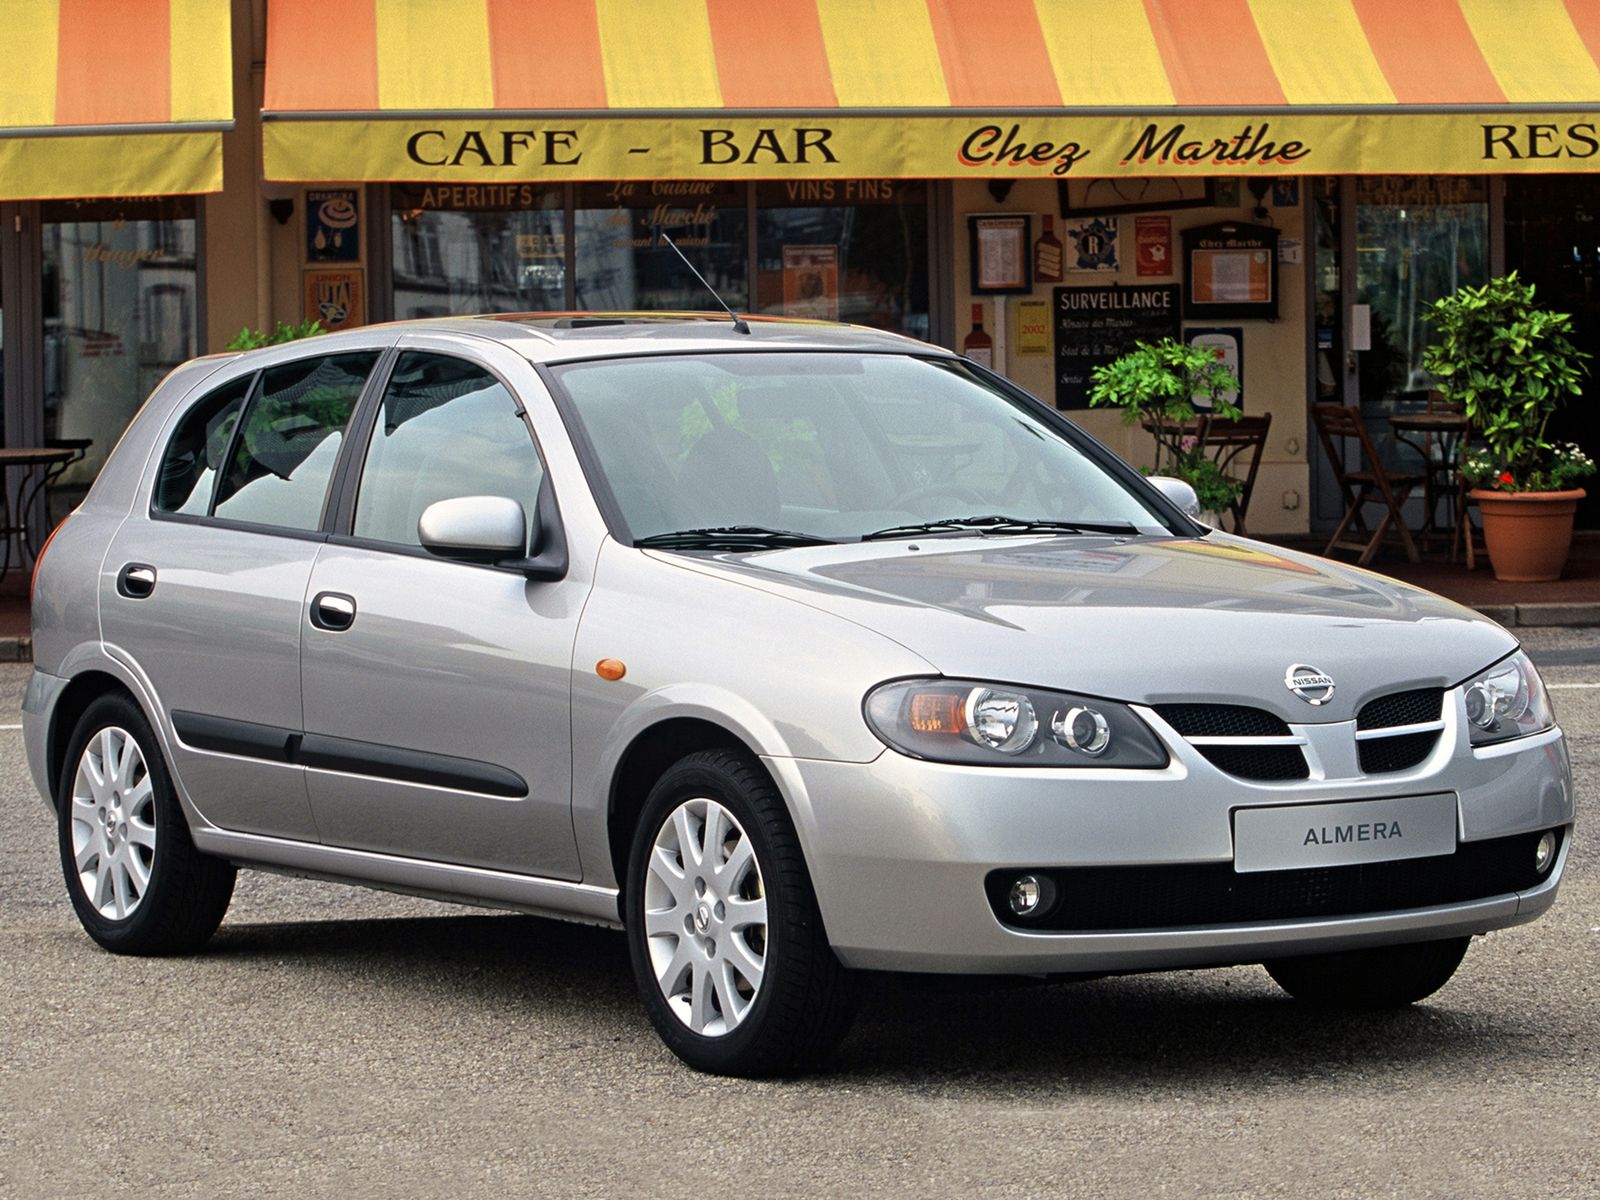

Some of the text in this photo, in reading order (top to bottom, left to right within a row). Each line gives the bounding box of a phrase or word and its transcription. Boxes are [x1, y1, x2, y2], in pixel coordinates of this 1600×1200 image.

[406, 130, 583, 166] CAFE
[699, 128, 840, 164] BAR
[958, 122, 1312, 176] Chez Marthe
[1481, 123, 1600, 160] RES
[420, 184, 533, 209] APERITIFS
[650, 180, 716, 197] Cuisine
[785, 179, 893, 201] VINS FINS
[641, 203, 717, 226] Marché
[1060, 291, 1172, 310] SURVEILLANCE
[1022, 325, 1045, 334] 2002
[1293, 676, 1332, 685] NISSAN
[1303, 821, 1402, 846] ALMERA
